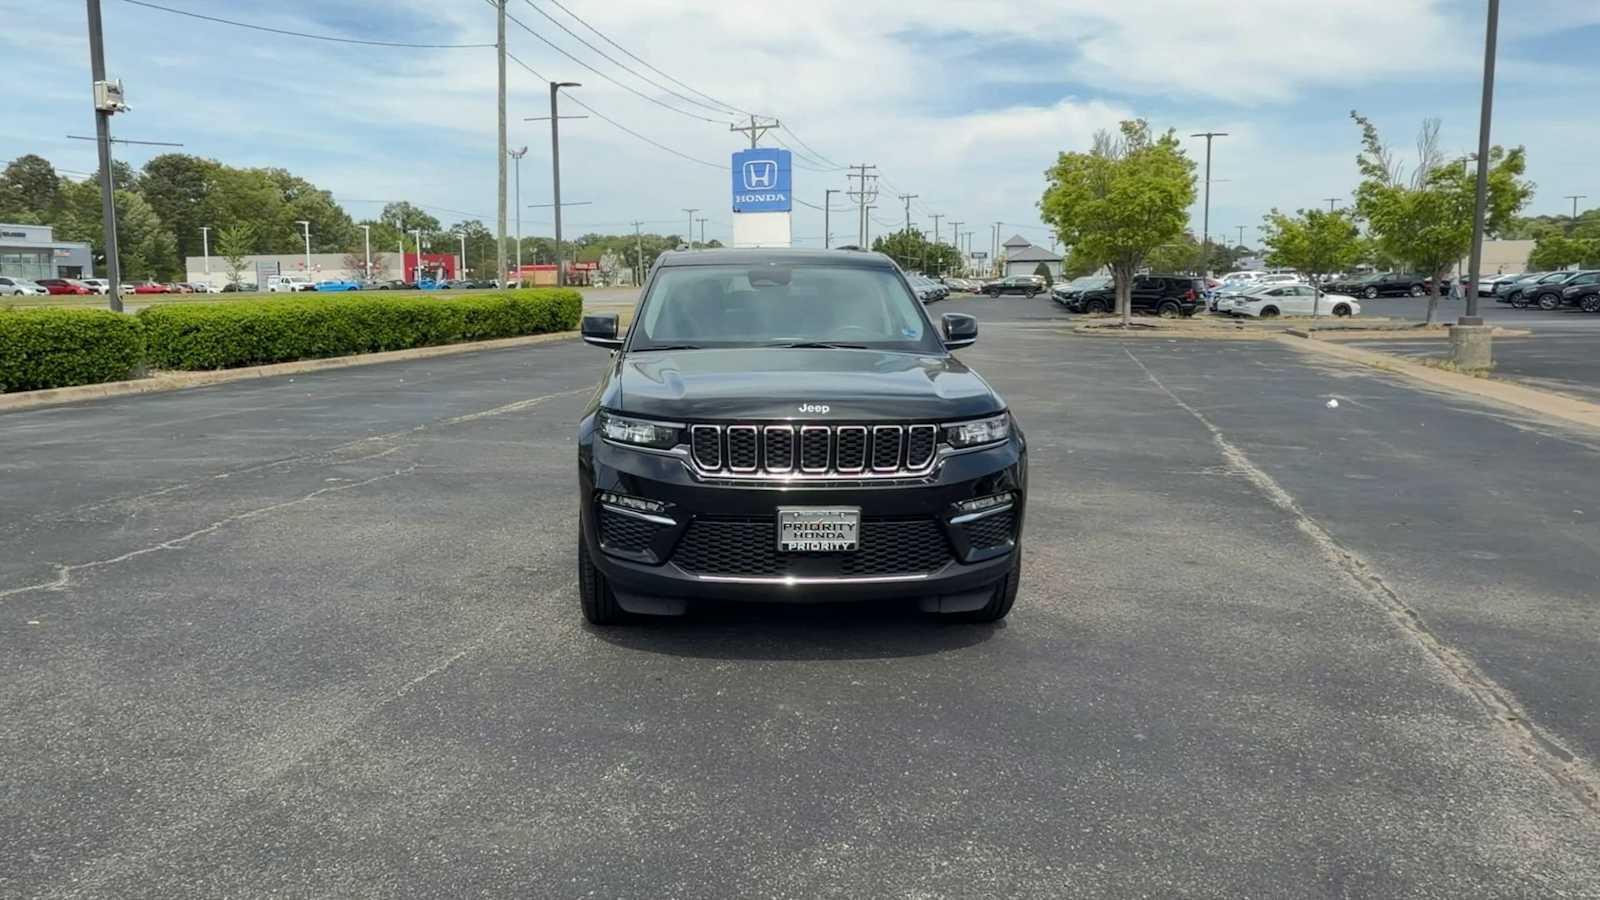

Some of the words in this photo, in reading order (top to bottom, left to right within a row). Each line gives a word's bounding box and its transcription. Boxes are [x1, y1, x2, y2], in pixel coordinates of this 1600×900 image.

[736, 194, 786, 203] HONDA
[798, 403, 830, 414] Jeep
[783, 522, 856, 531] PRIORITY
[788, 542, 849, 551] PRIORITY
